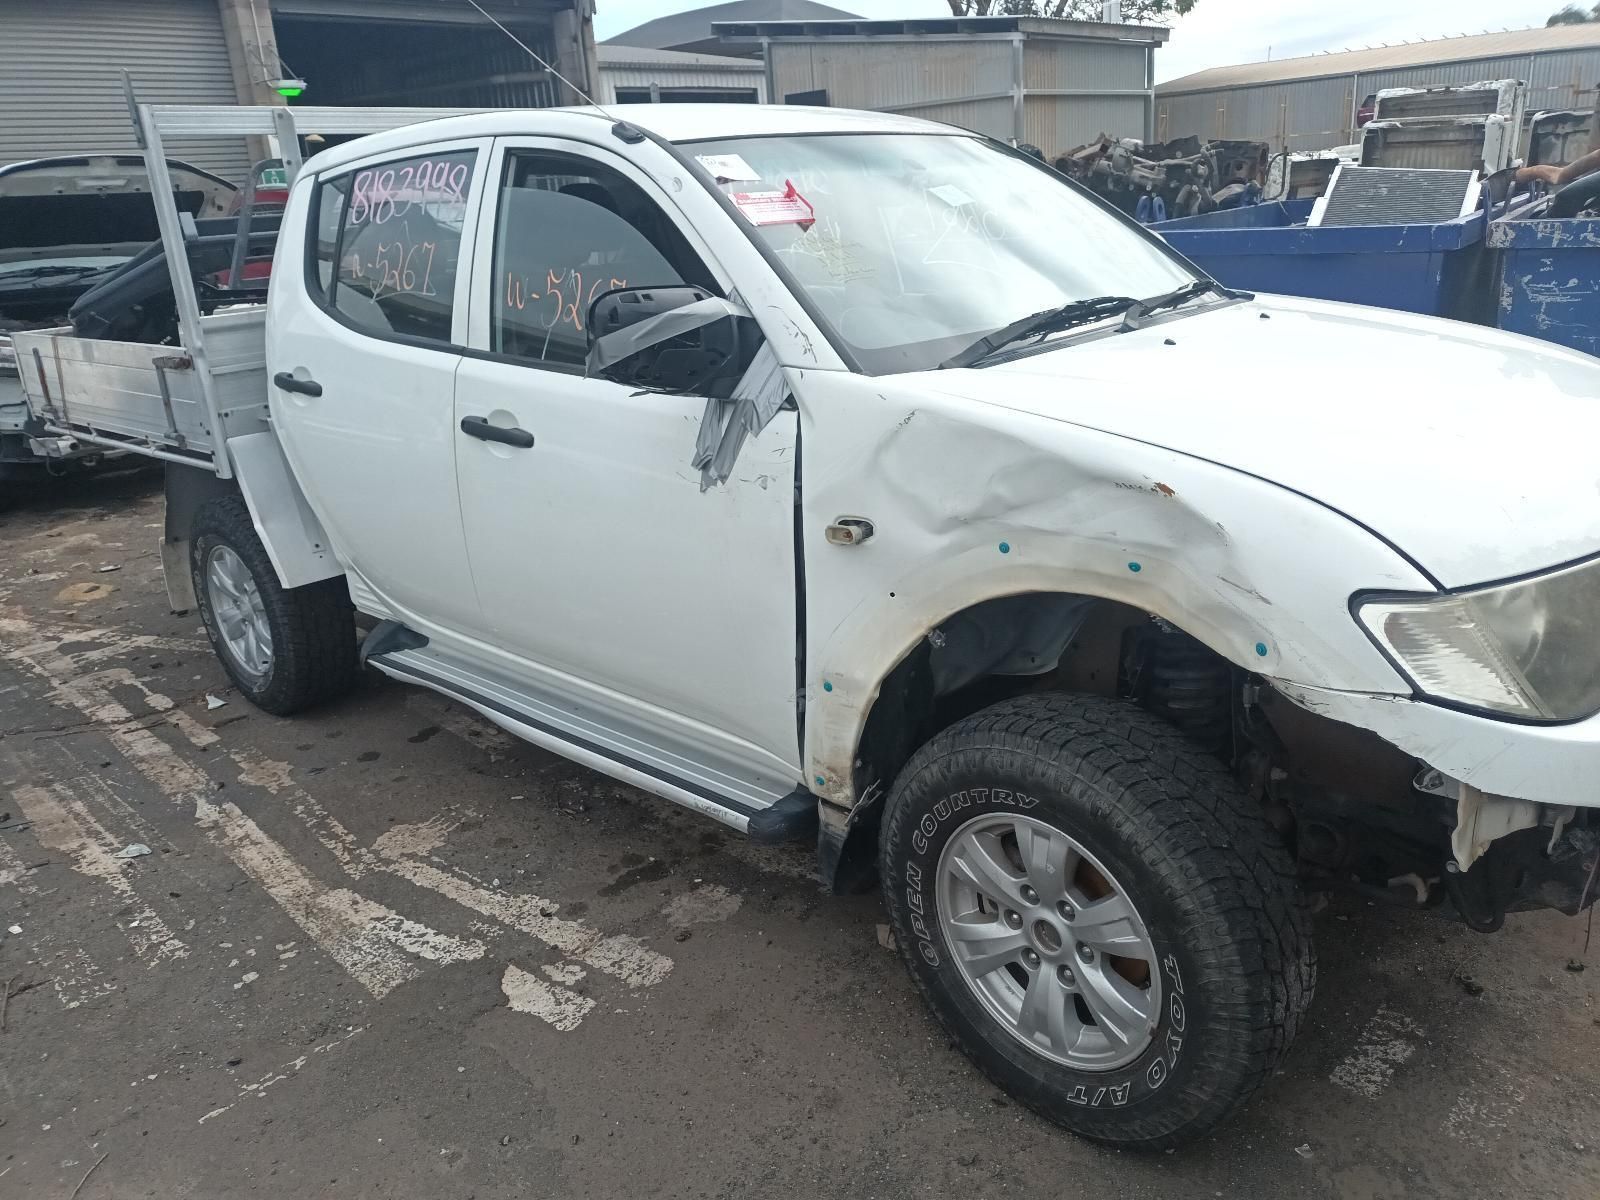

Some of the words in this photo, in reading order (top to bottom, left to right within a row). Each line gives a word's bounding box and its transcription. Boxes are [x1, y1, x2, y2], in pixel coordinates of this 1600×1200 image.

[352, 160, 468, 224] 8183998
[912, 788, 1038, 855] COUNTRY
[907, 862, 941, 967] OPEN
[1146, 953, 1188, 1090] TOYO
[1067, 1081, 1131, 1106] A/T
